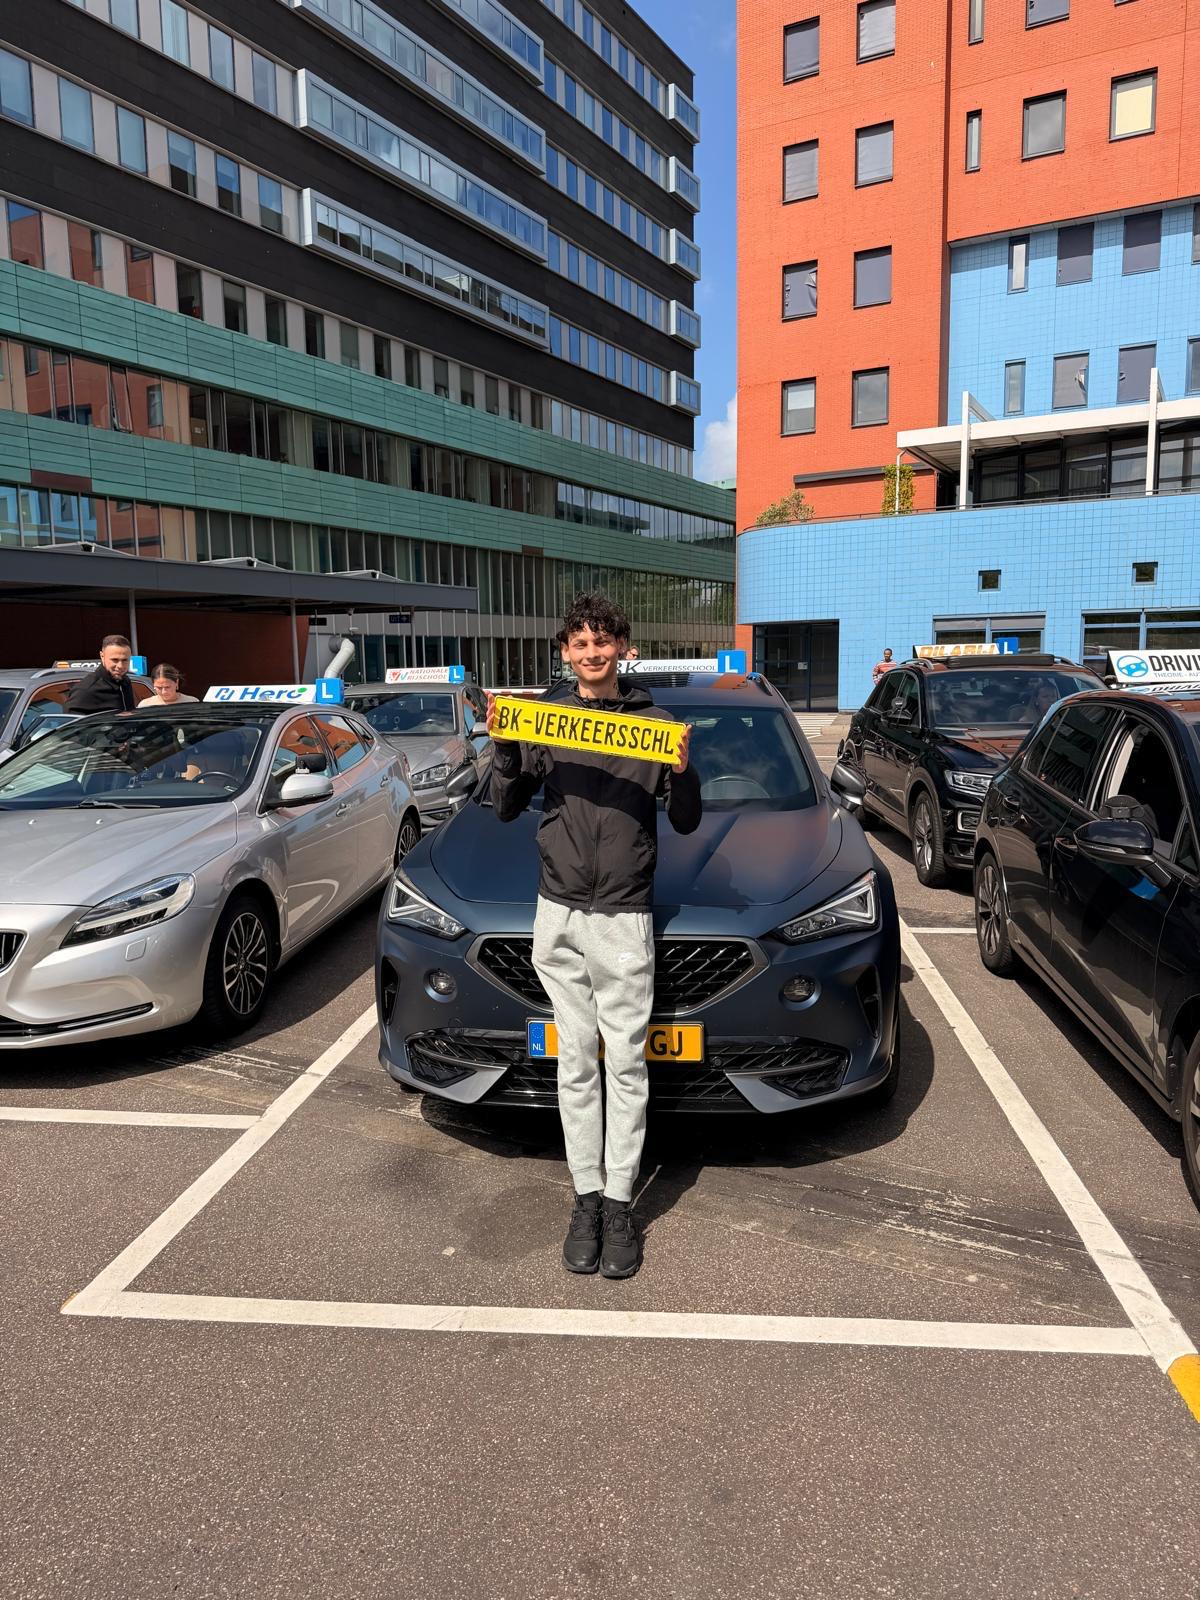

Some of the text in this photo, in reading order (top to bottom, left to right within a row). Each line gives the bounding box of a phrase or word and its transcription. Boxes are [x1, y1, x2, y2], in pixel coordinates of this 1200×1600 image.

[1003, 641, 1014, 655] L
[129, 659, 138, 672] L
[724, 655, 739, 673] L
[1148, 654, 1200, 672] DRIVI
[406, 673, 447, 681] RIJSCHOOL
[453, 668, 461, 679] L
[239, 686, 305, 701] Hero
[321, 682, 334, 699] L
[498, 706, 674, 755] BK-VERKEERSSCHL
[532, 1042, 544, 1052] NL
